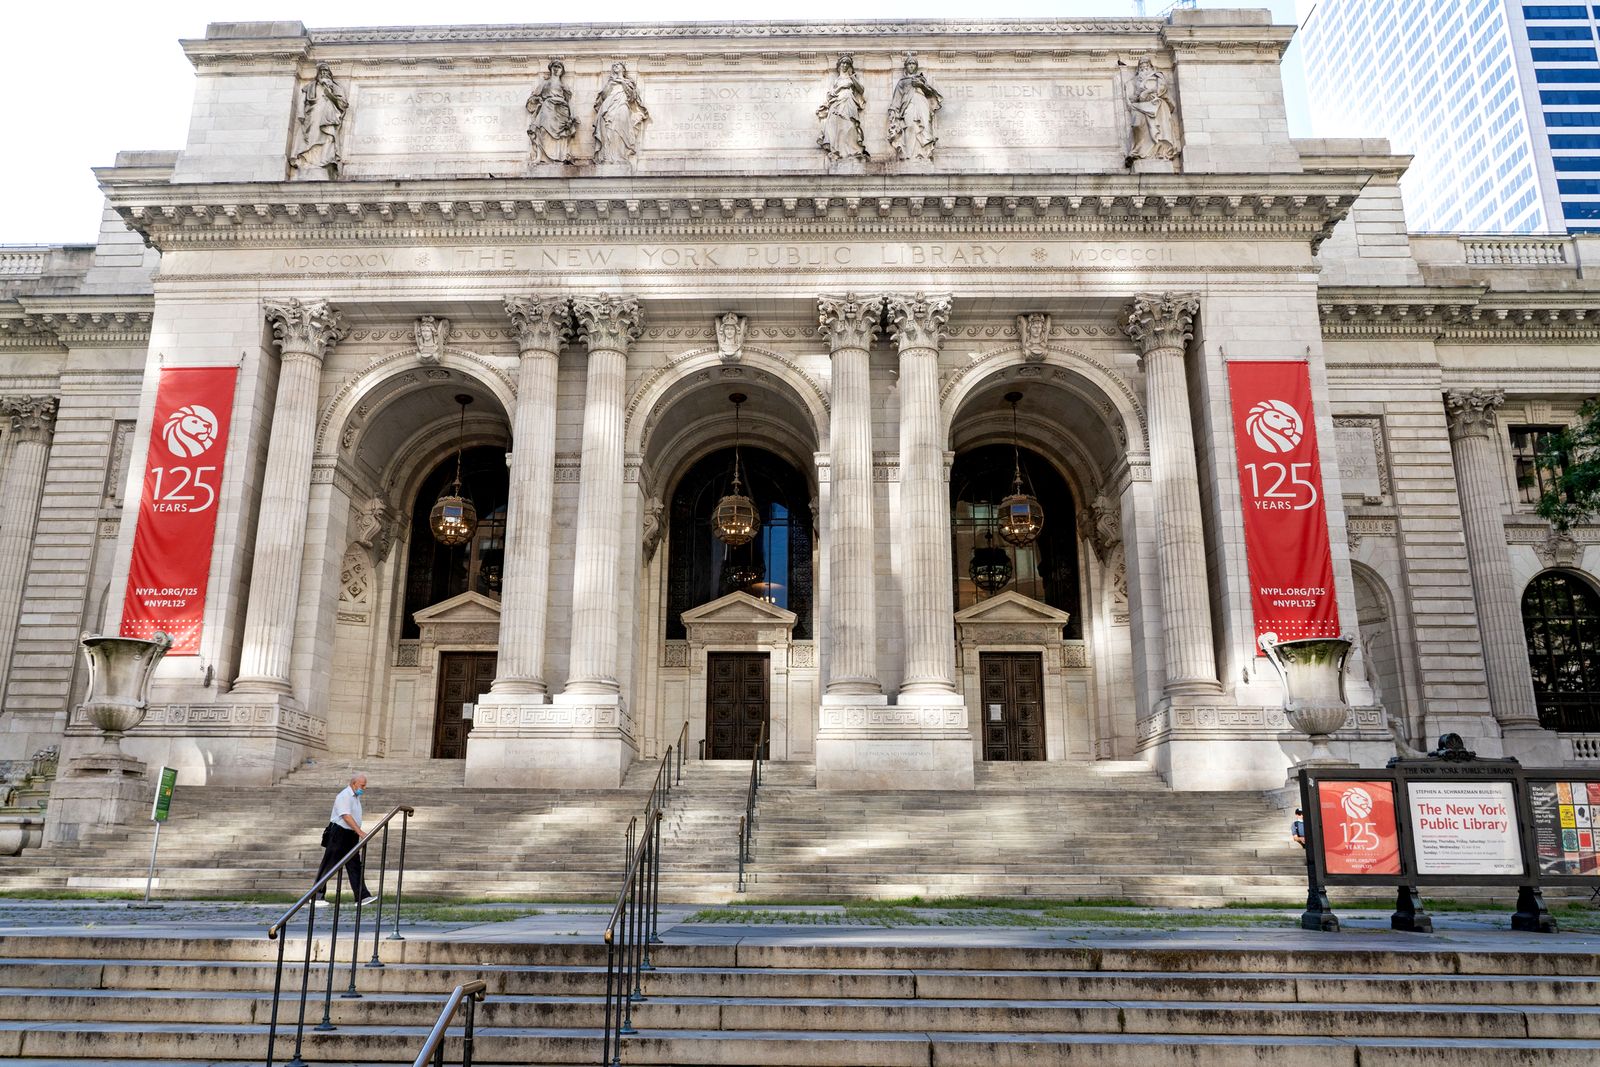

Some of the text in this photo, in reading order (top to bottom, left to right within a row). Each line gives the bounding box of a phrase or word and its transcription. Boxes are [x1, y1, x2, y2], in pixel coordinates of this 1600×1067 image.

[654, 87, 813, 99] THE LENOX LIBRARY
[947, 85, 1103, 98] THE TILDEN TRUST
[367, 91, 522, 105] THE ASTOR LIBRARY
[464, 107, 474, 115] BY
[688, 112, 776, 121] JAMES LENOX
[1052, 110, 1090, 118] TILDEN
[384, 115, 498, 126] JOHN JACOB ASTOR
[974, 120, 1000, 128] SERVE
[1006, 120, 1024, 128] THE
[283, 254, 393, 269] MDCCCXCV
[456, 249, 517, 269] THE
[541, 248, 615, 267] NEW
[642, 247, 721, 267] YORK
[747, 246, 853, 266] PUBLIC
[881, 245, 1007, 266] LIBRARY
[151, 466, 216, 513] 125
[1244, 462, 1318, 511] 125
[152, 503, 188, 513] YEARS
[1254, 501, 1292, 510] YEARS
[135, 587, 198, 597] NYPL.ORG/125
[1260, 587, 1326, 597] NYPL.ORG/125
[143, 599, 186, 608] #NYPL125
[1417, 803, 1506, 815] The New York
[1420, 818, 1507, 833] Public Library
[1339, 822, 1379, 850] 125
